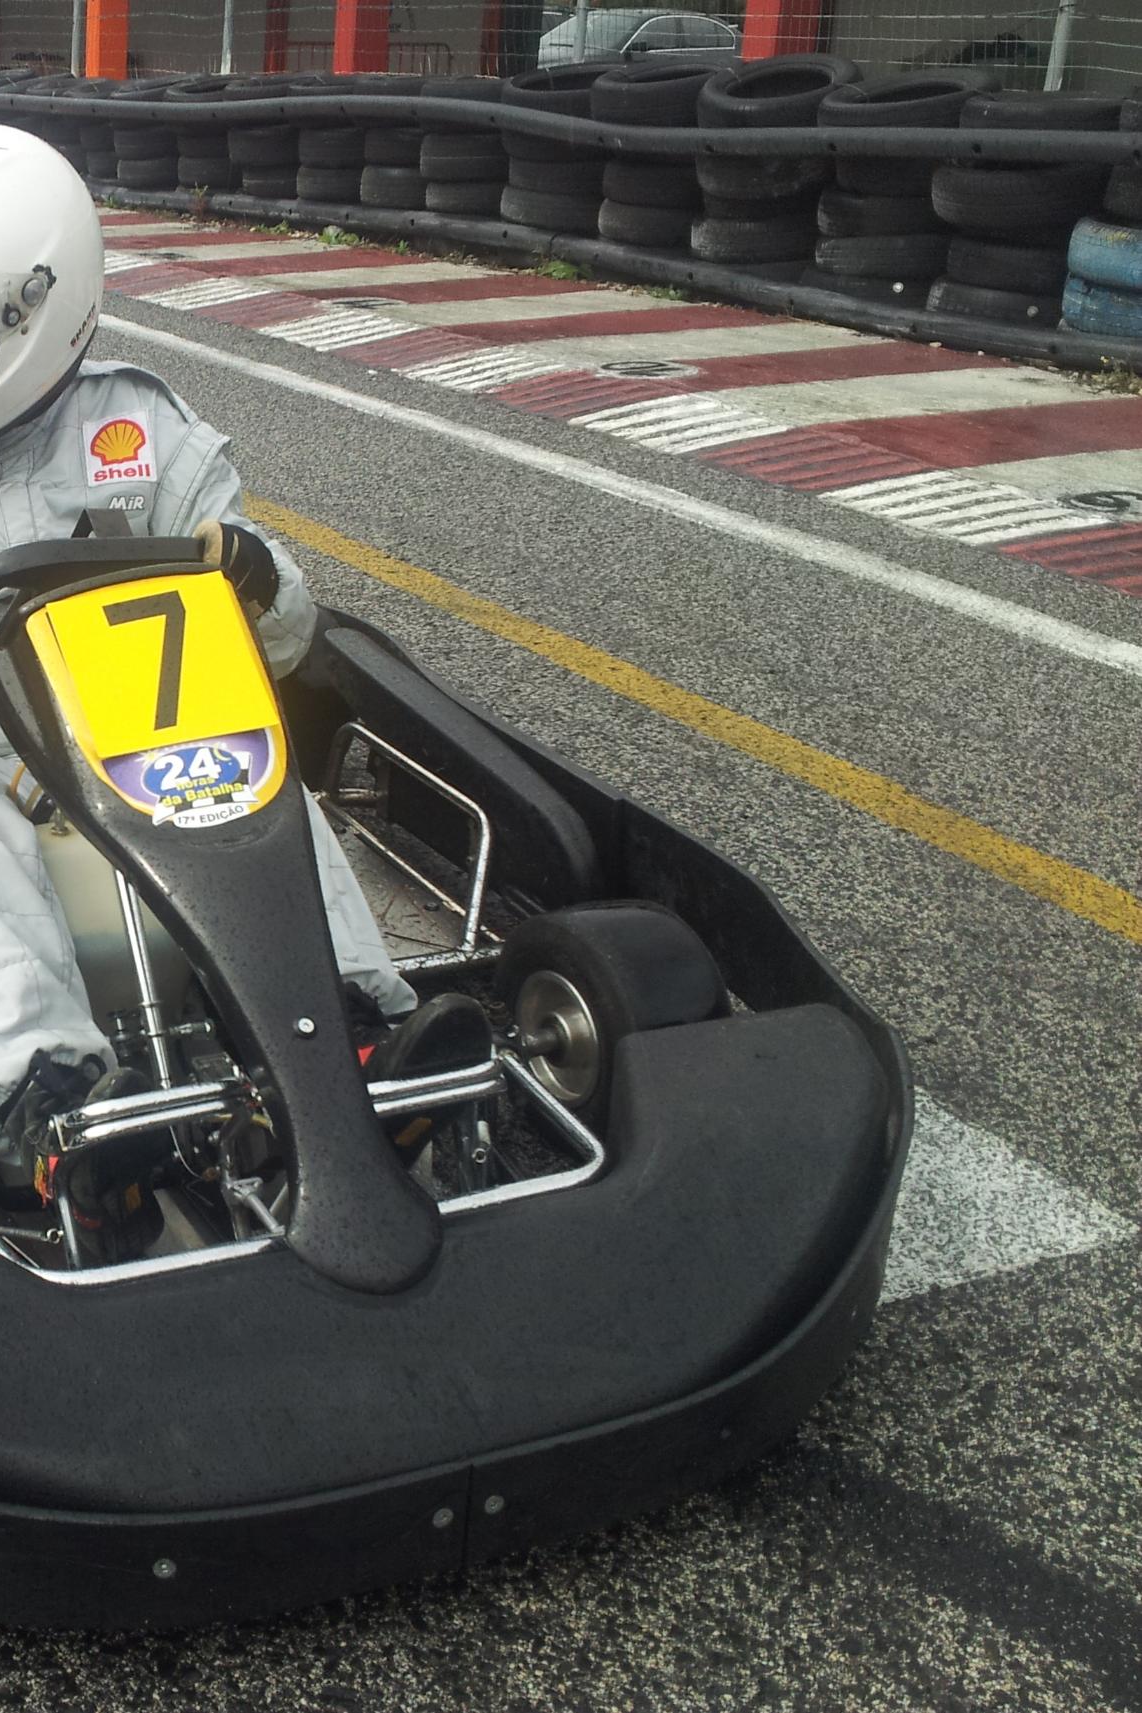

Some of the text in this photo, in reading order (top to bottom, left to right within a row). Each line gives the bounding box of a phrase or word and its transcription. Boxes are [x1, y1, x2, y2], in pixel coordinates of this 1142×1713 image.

[102, 590, 186, 731] 7
[154, 747, 222, 791] 24
[161, 782, 245, 808] da Batalha
[199, 804, 245, 824] EDIÇÃO
